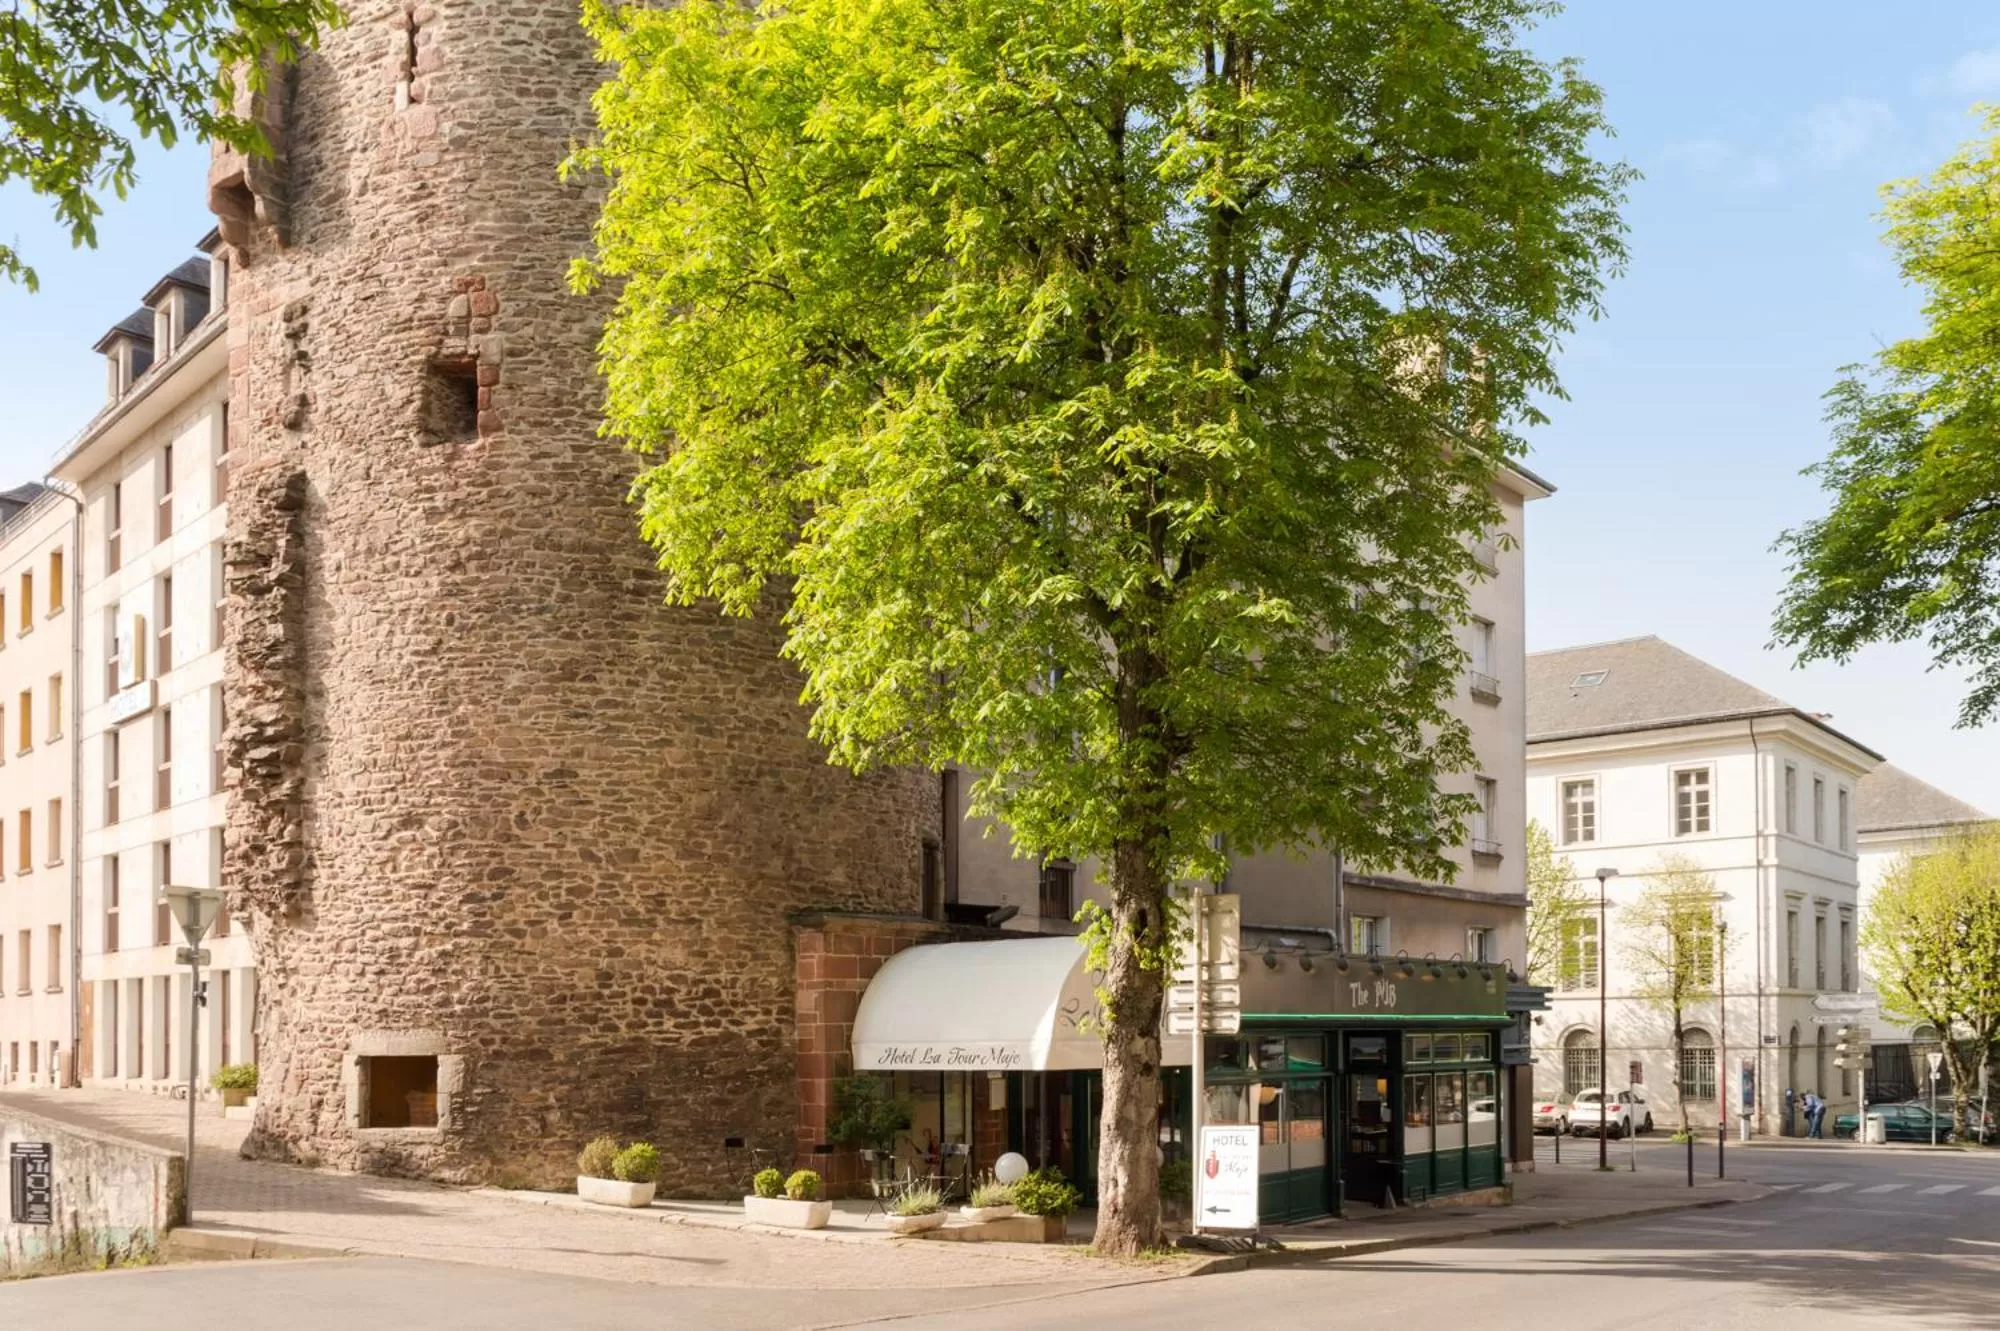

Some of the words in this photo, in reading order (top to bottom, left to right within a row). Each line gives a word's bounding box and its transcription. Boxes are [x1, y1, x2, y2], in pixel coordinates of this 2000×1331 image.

[1349, 981, 1369, 1008] The
[1374, 978, 1397, 1008] PUB
[878, 1046, 918, 1065] Hotel
[919, 1046, 942, 1064] La
[947, 1046, 981, 1065] Tour
[1212, 1135, 1249, 1146] HOTEL
